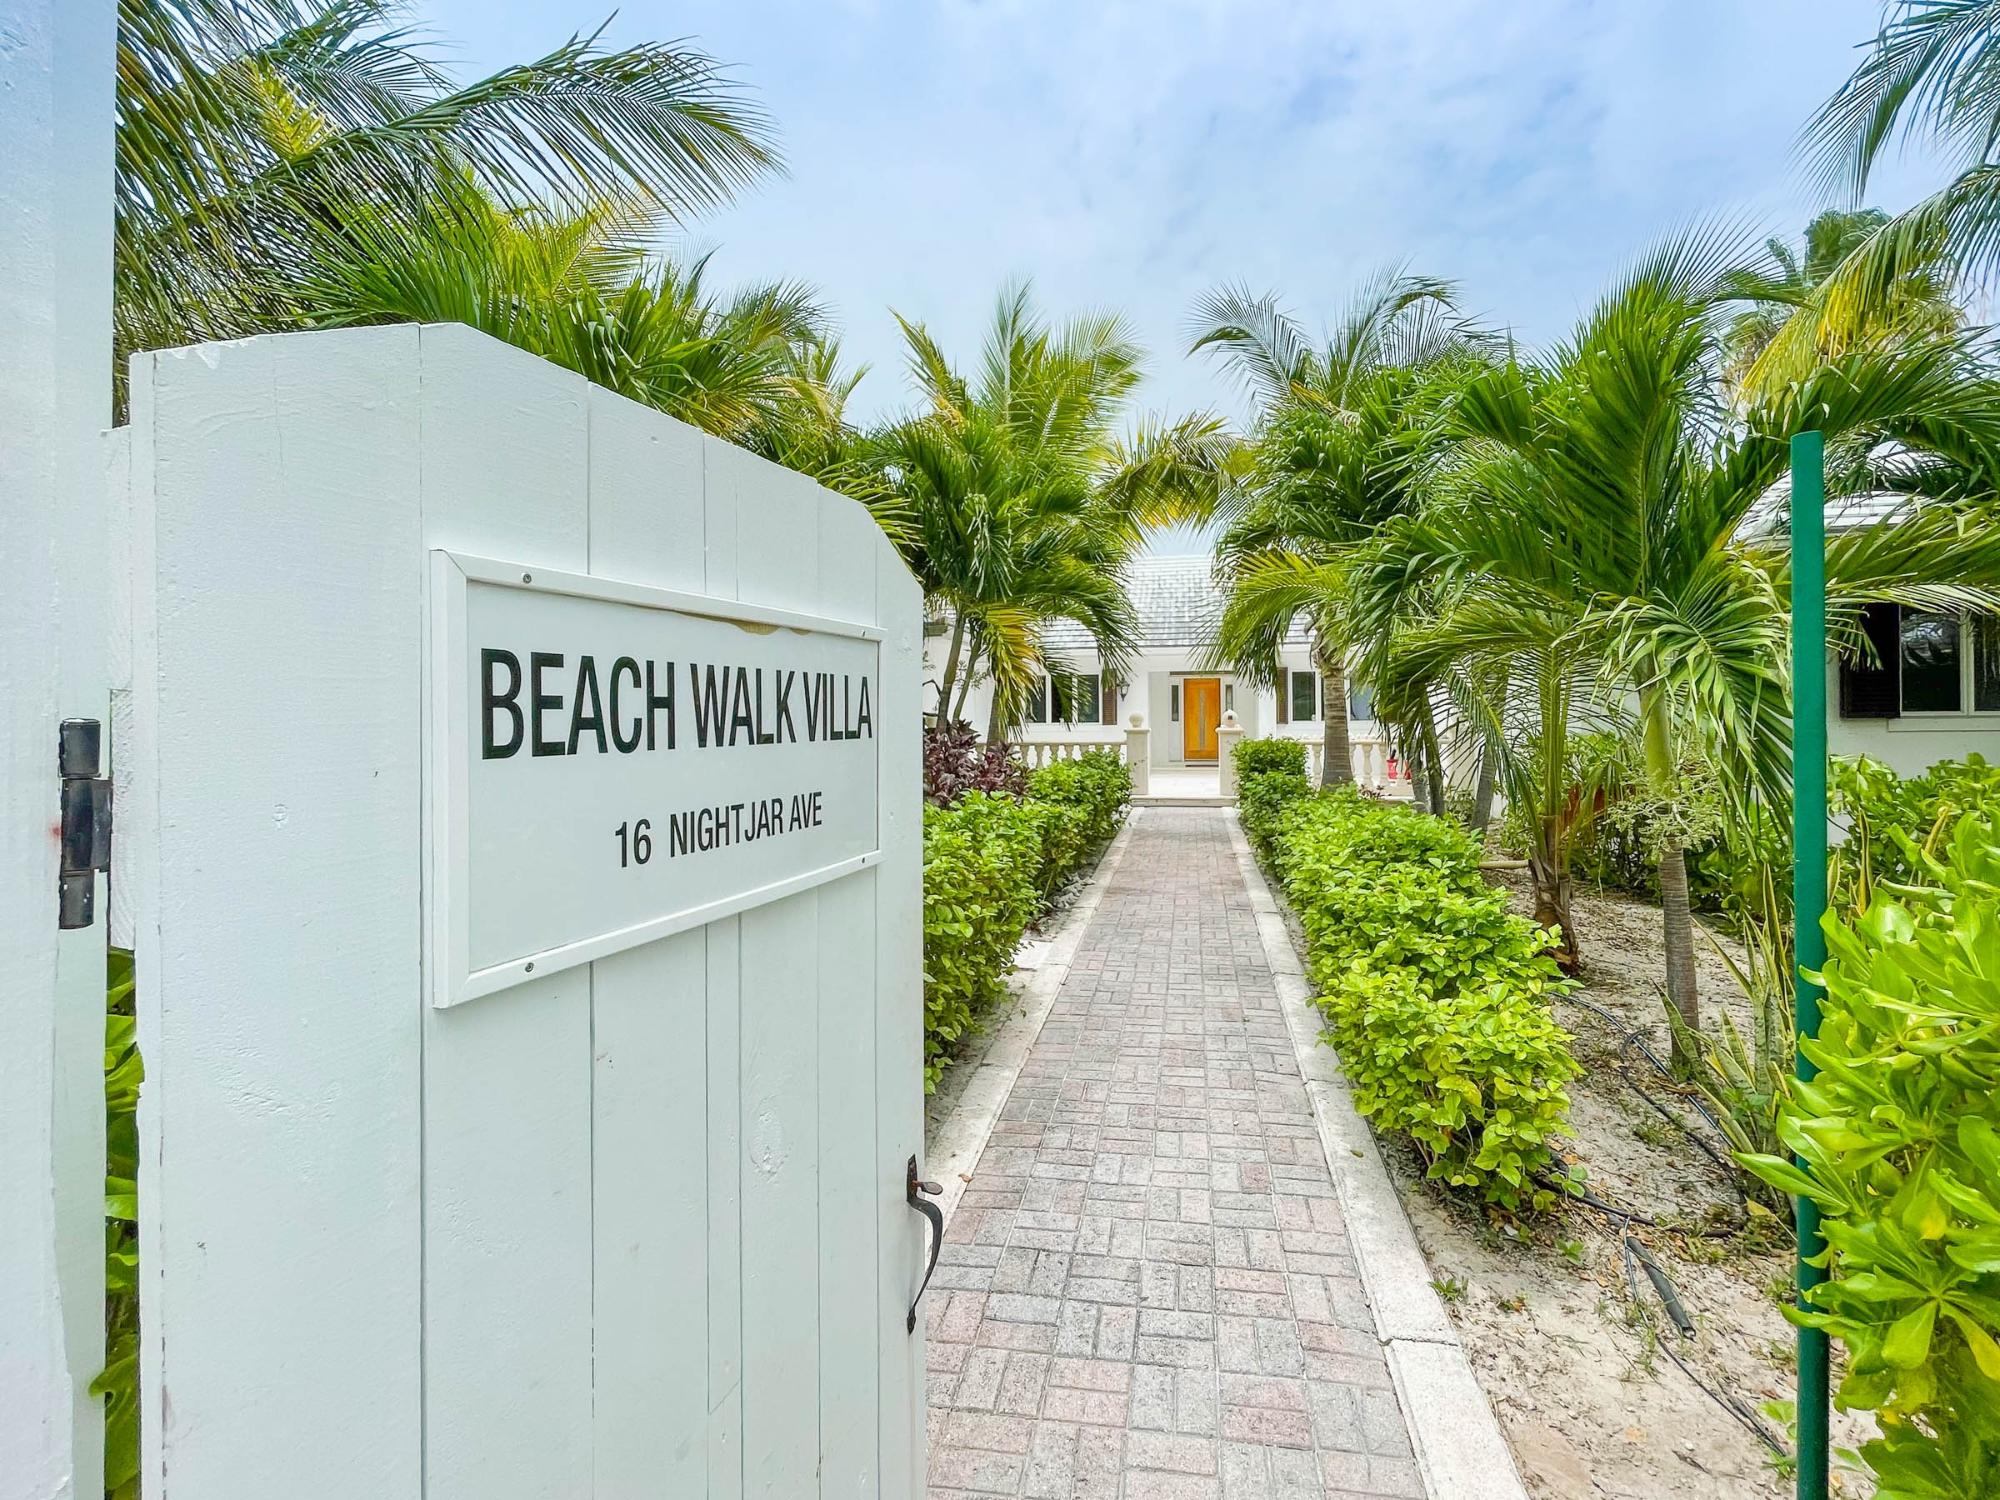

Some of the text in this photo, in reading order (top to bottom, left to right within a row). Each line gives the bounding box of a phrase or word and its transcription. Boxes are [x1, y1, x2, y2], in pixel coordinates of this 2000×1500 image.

[481, 647, 874, 760] BEACH WALK VILLA
[614, 791, 823, 869] 16 NIGHTJAR AVE
